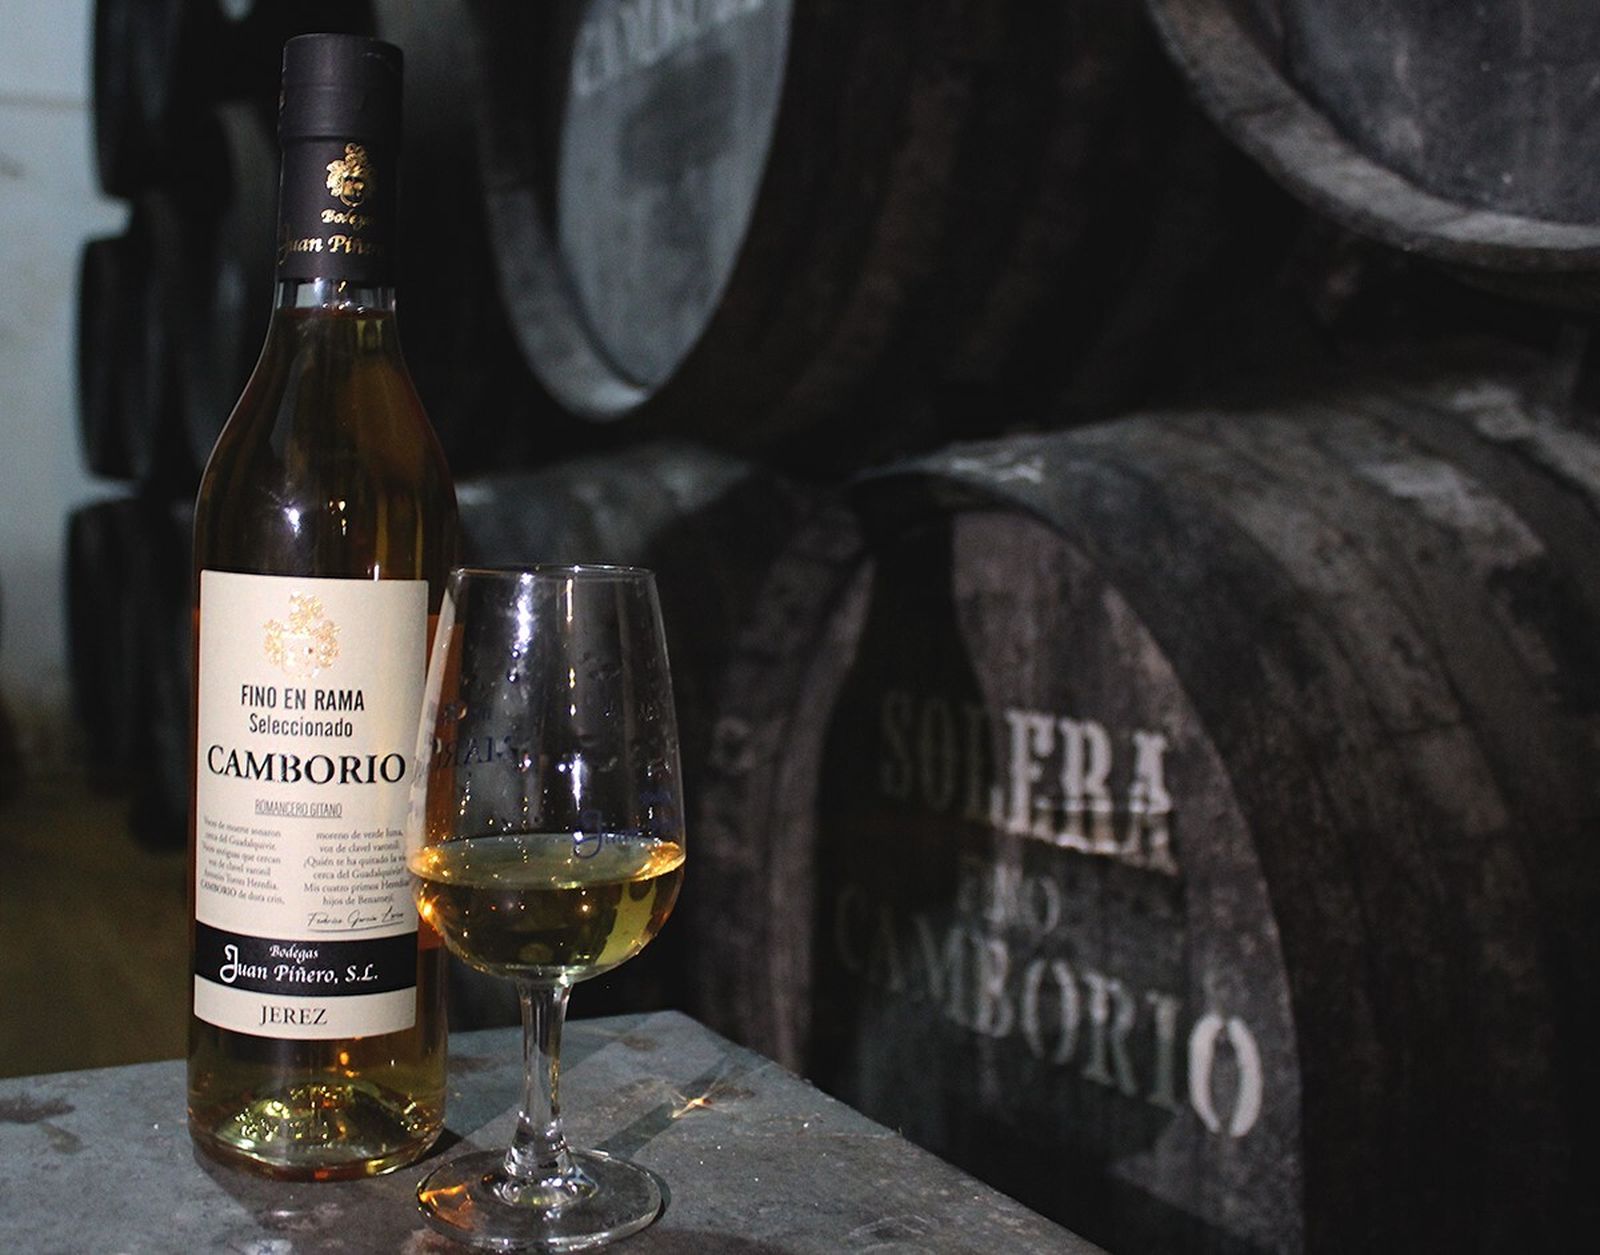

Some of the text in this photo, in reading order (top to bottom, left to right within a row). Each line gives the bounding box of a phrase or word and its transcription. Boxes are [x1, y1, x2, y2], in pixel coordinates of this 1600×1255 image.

[241, 685, 365, 711] FINO EN RAMA
[249, 713, 354, 738] Seleccionado
[207, 744, 406, 785] CAMBORIO
[255, 798, 343, 818] ROMANCERO GITANO
[219, 943, 379, 985] Juan Piñero, S.L.
[268, 943, 319, 964] Bodegas
[259, 1004, 328, 1026] JEREZ
[833, 880, 1265, 1138] CAMBORIO
